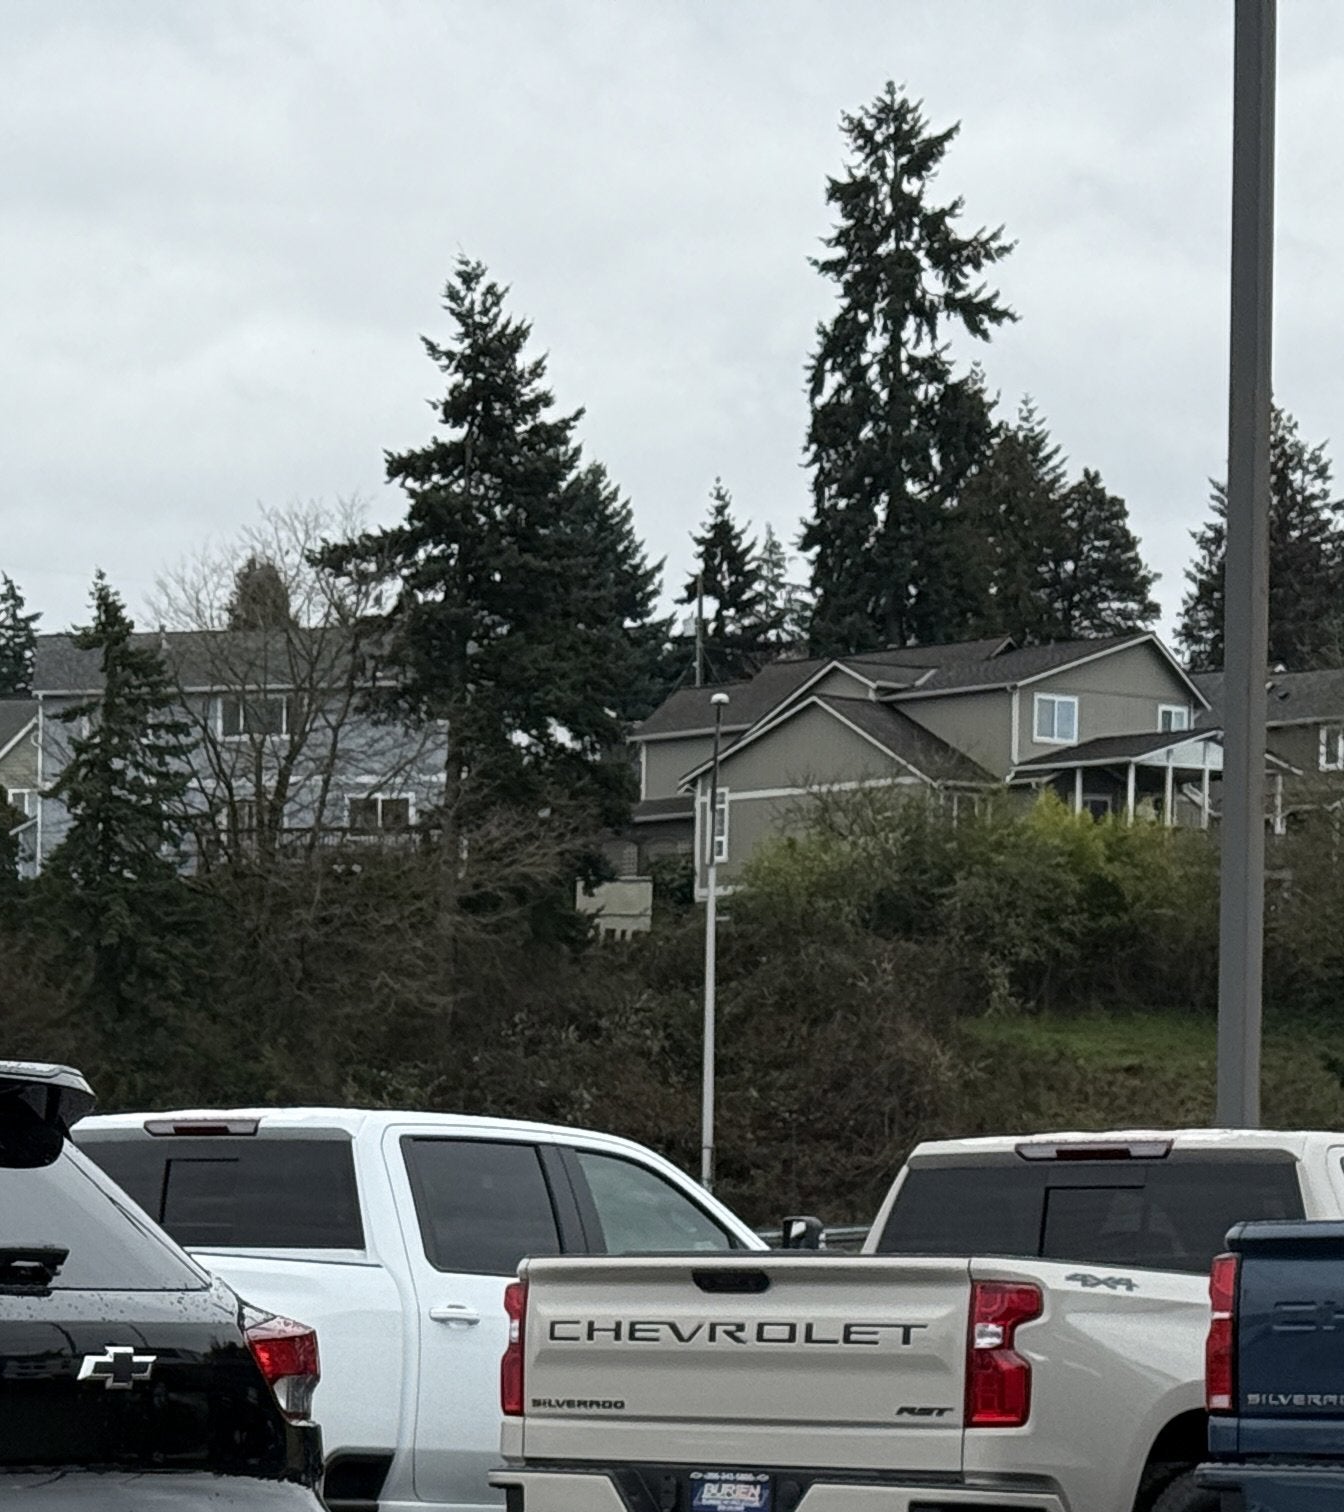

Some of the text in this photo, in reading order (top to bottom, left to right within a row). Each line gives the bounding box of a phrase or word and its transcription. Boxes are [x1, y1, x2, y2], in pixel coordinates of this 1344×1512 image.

[548, 1319, 929, 1346] CHEVROLET
[531, 1398, 625, 1410] SILVERADO
[895, 1406, 955, 1418] RST
[703, 1483, 761, 1500] BURIEN
